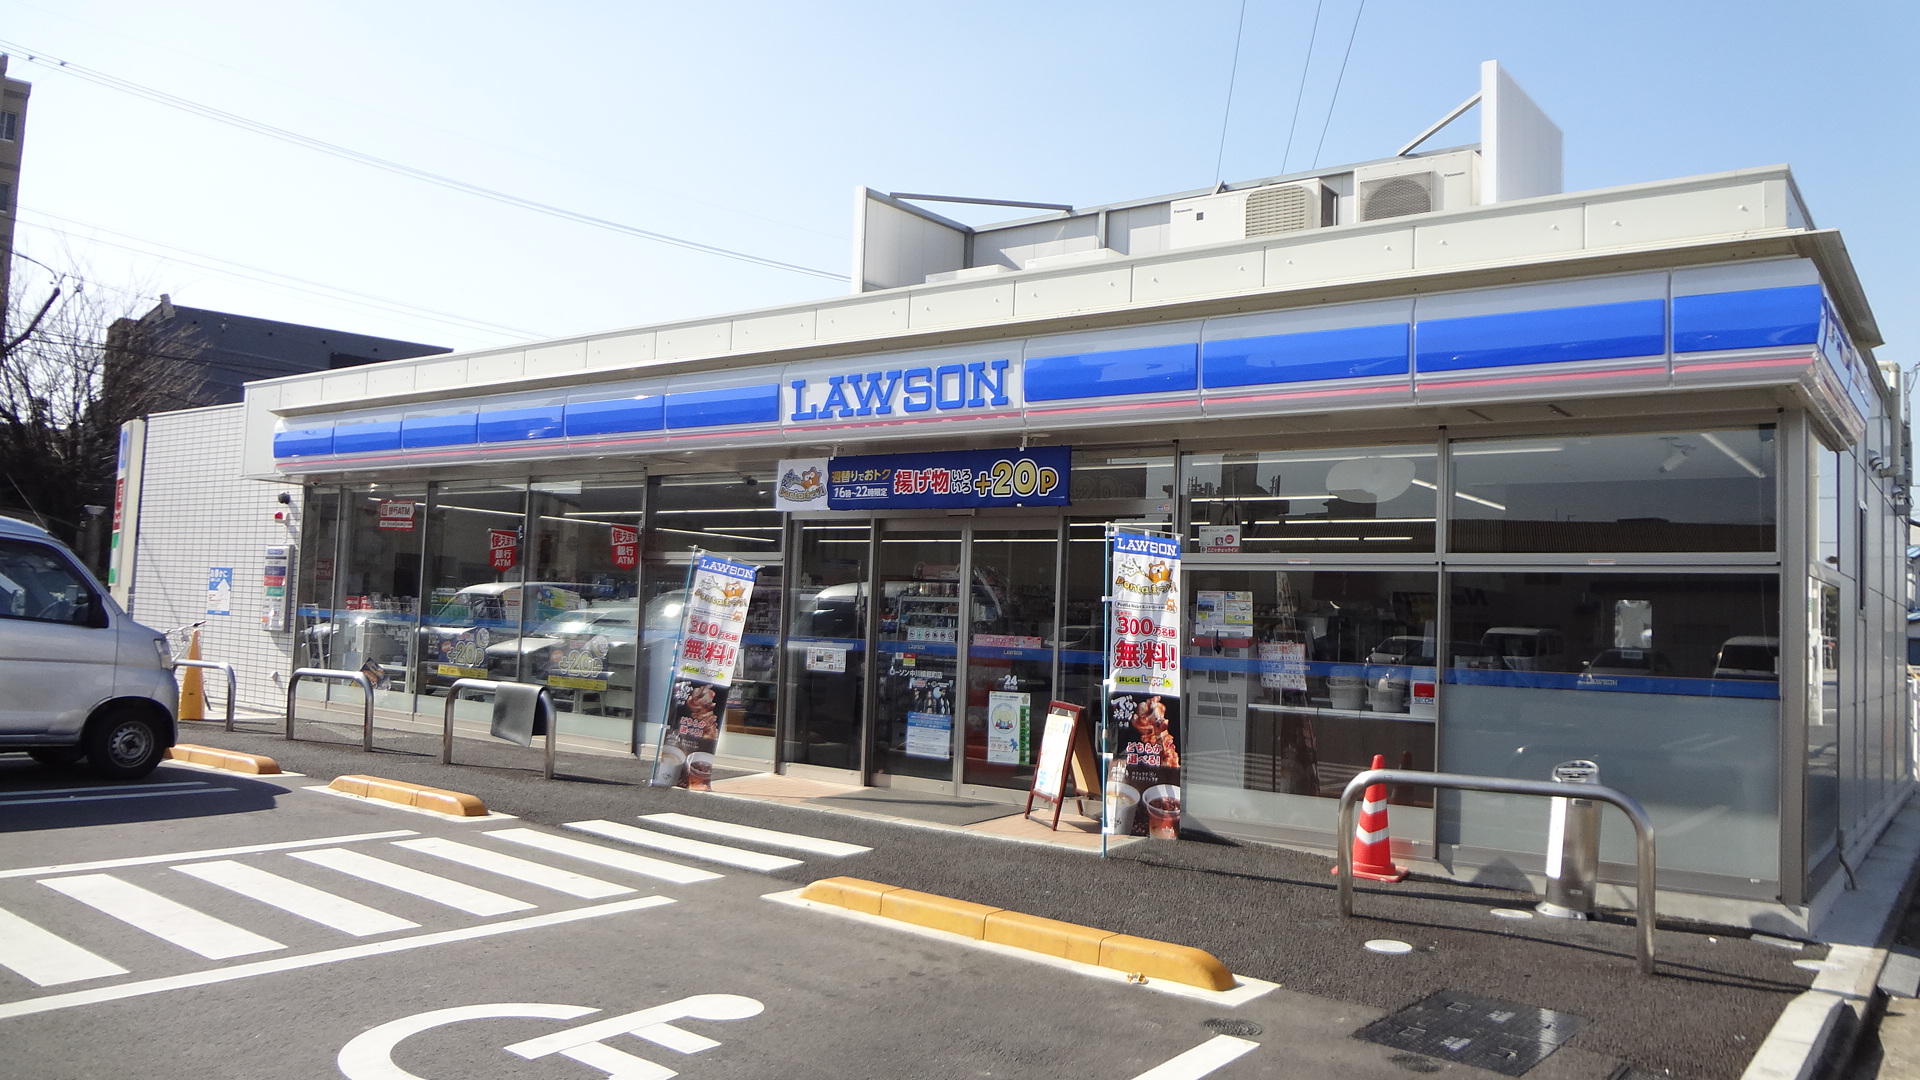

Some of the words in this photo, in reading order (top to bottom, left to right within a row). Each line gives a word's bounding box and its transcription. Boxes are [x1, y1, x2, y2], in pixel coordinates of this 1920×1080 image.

[790, 359, 1009, 421] LAWSON
[832, 469, 891, 483] 週替りでおトク
[894, 468, 950, 494] 揚げ物
[952, 469, 972, 481] いろ
[951, 481, 972, 494] いろ
[617, 545, 634, 556] 銀行
[1117, 538, 1178, 556] LAWSON
[495, 549, 512, 559] 銀行
[617, 556, 634, 564] ATM
[494, 559, 511, 567] ATM
[701, 559, 755, 580] LAWSON
[683, 637, 737, 667] 無料!
[1115, 639, 1177, 670] 無料!
[1004, 674, 1018, 686] 24
[1126, 742, 1163, 754] どちらか
[1127, 753, 1161, 766] 選べる!
